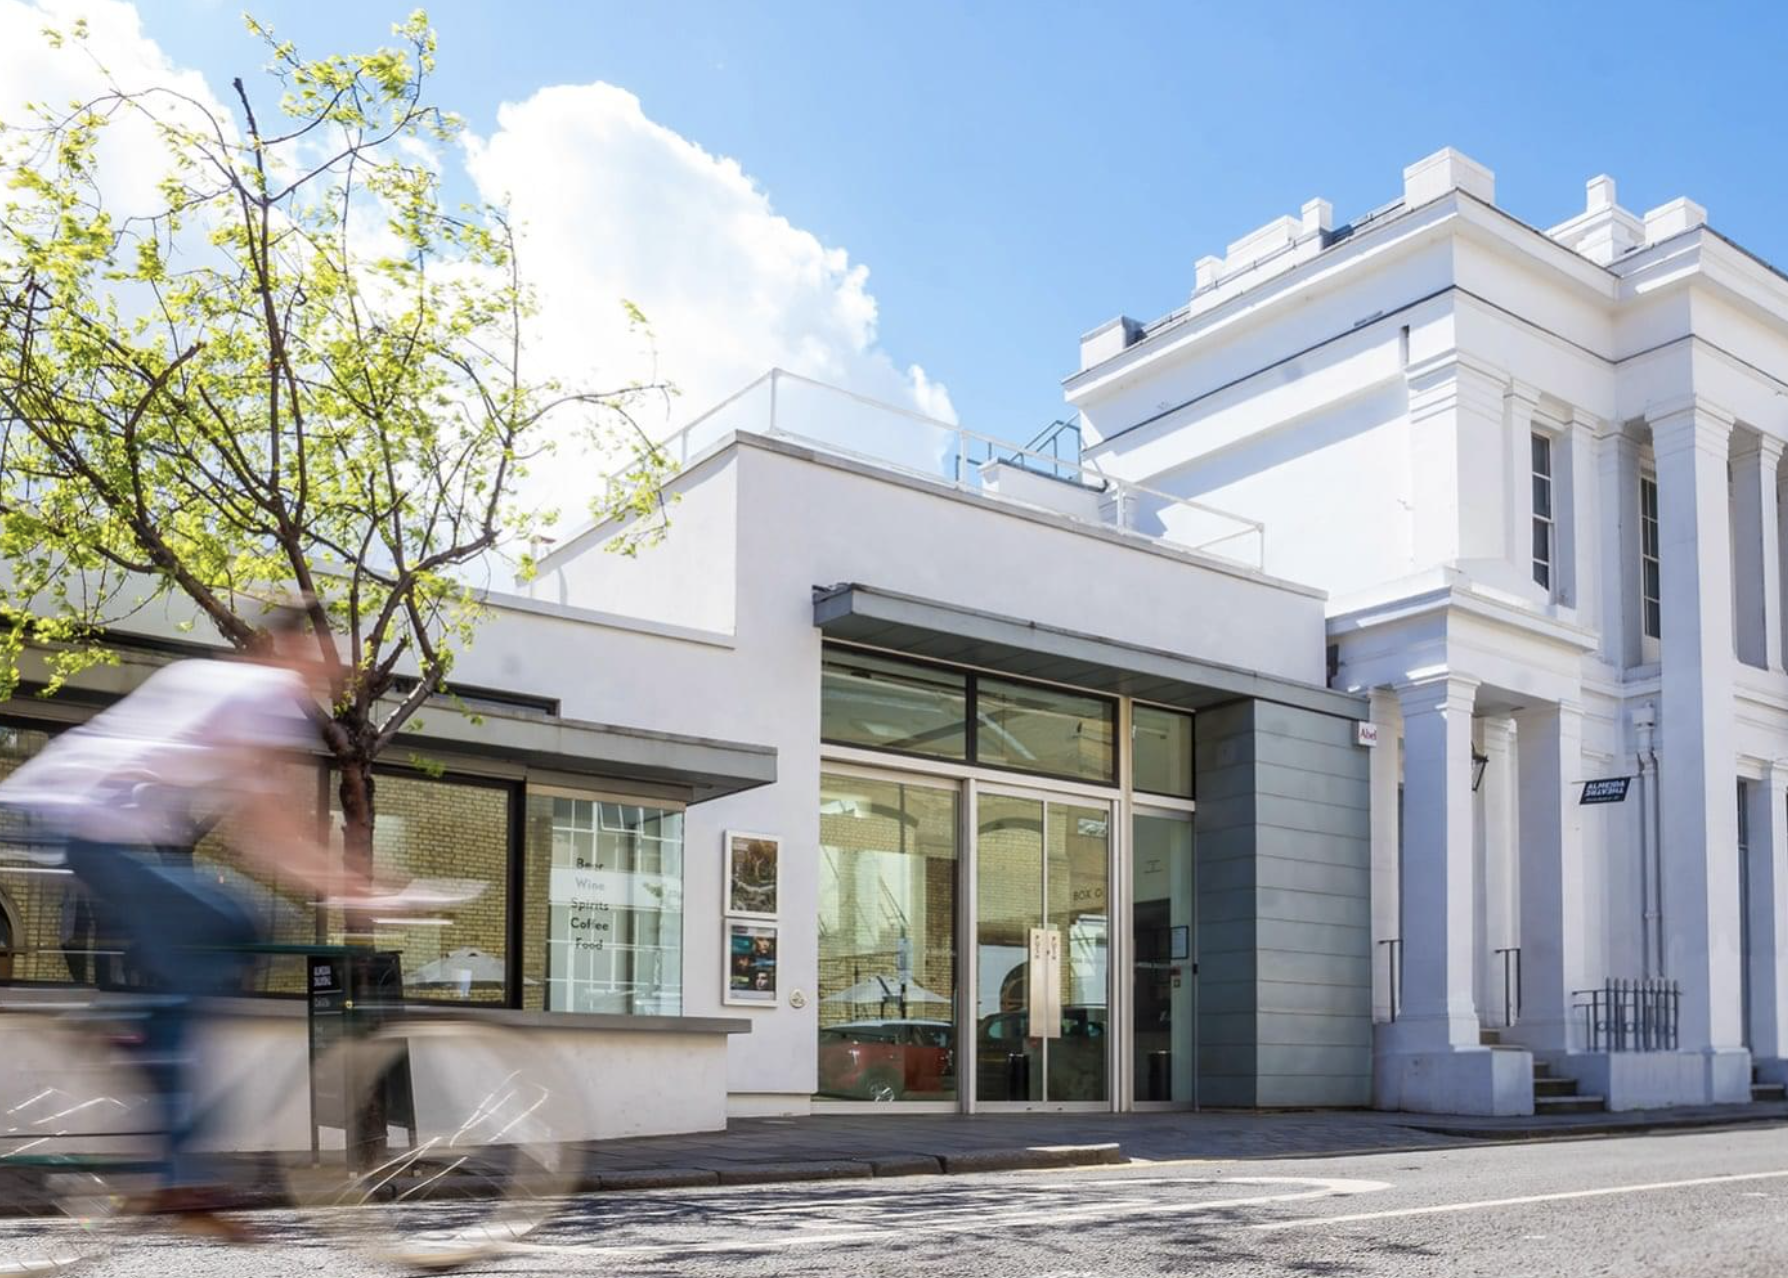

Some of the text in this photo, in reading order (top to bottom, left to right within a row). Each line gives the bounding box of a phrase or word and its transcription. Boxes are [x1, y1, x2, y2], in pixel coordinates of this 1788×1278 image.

[576, 857, 604, 870] Beer
[575, 876, 605, 891] Wine
[1073, 889, 1092, 901] BOX
[571, 897, 609, 911] Spirits
[571, 917, 609, 931] Coffee
[576, 937, 603, 950] Food
